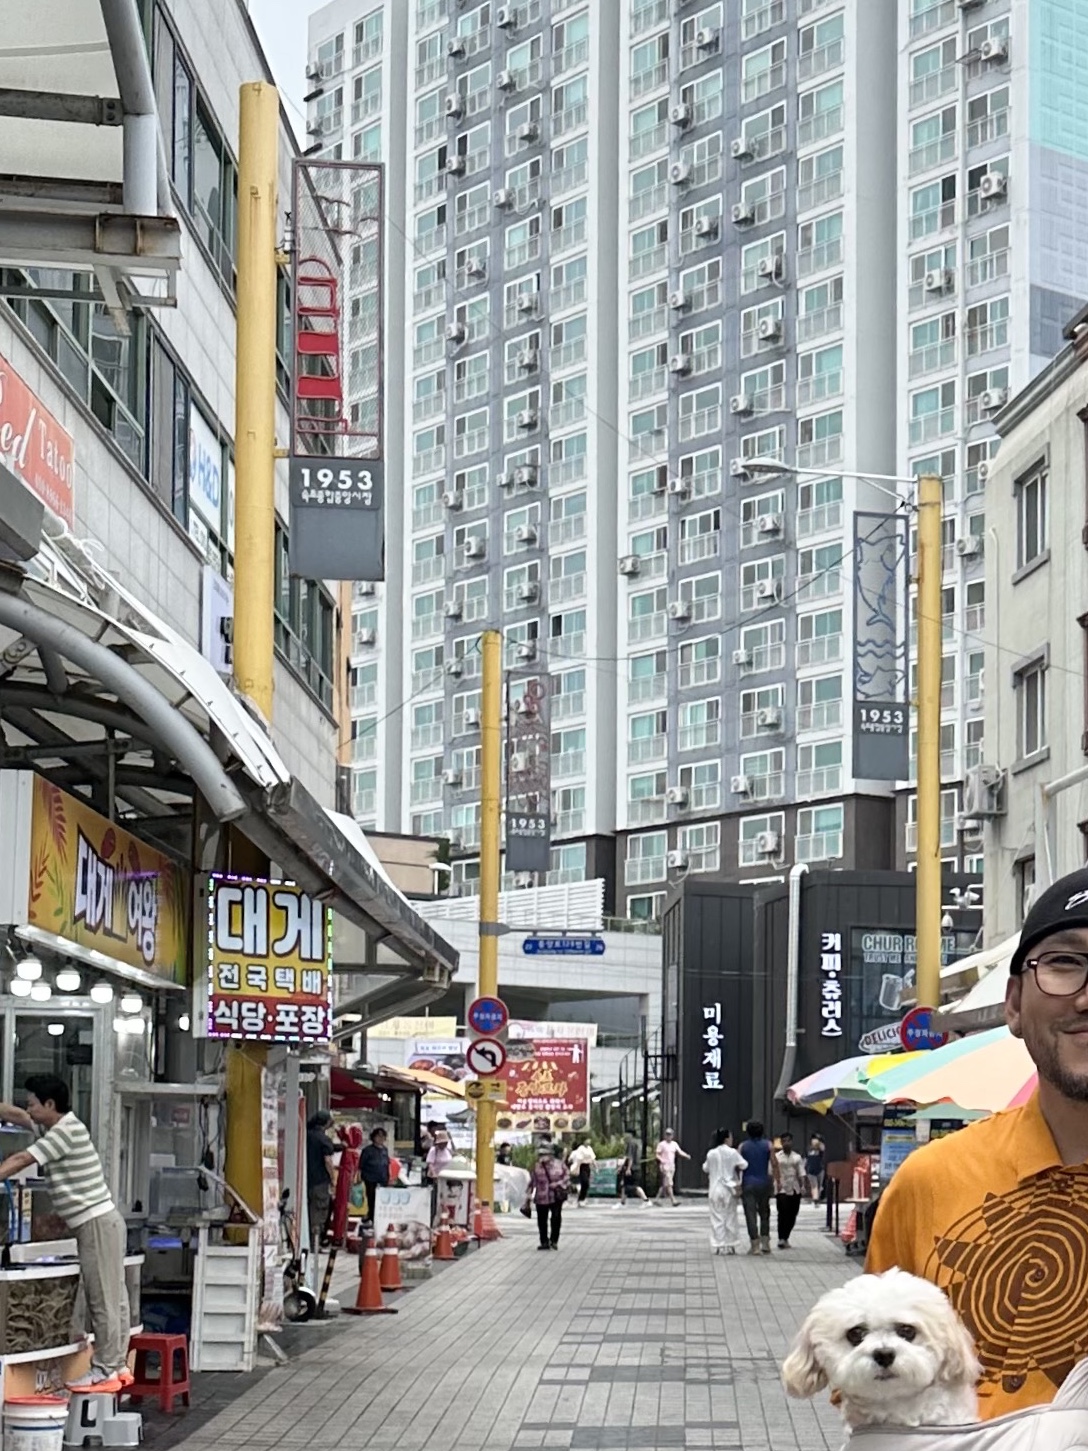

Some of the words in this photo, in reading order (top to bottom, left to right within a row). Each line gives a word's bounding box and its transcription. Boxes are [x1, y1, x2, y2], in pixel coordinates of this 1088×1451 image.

[301, 468, 373, 490] 1953
[860, 708, 904, 724] 1953
[511, 818, 546, 829] 1953
[217, 886, 324, 960] 대게
[218, 963, 322, 995] 전국택배
[702, 1002, 724, 1090] 미용재료
